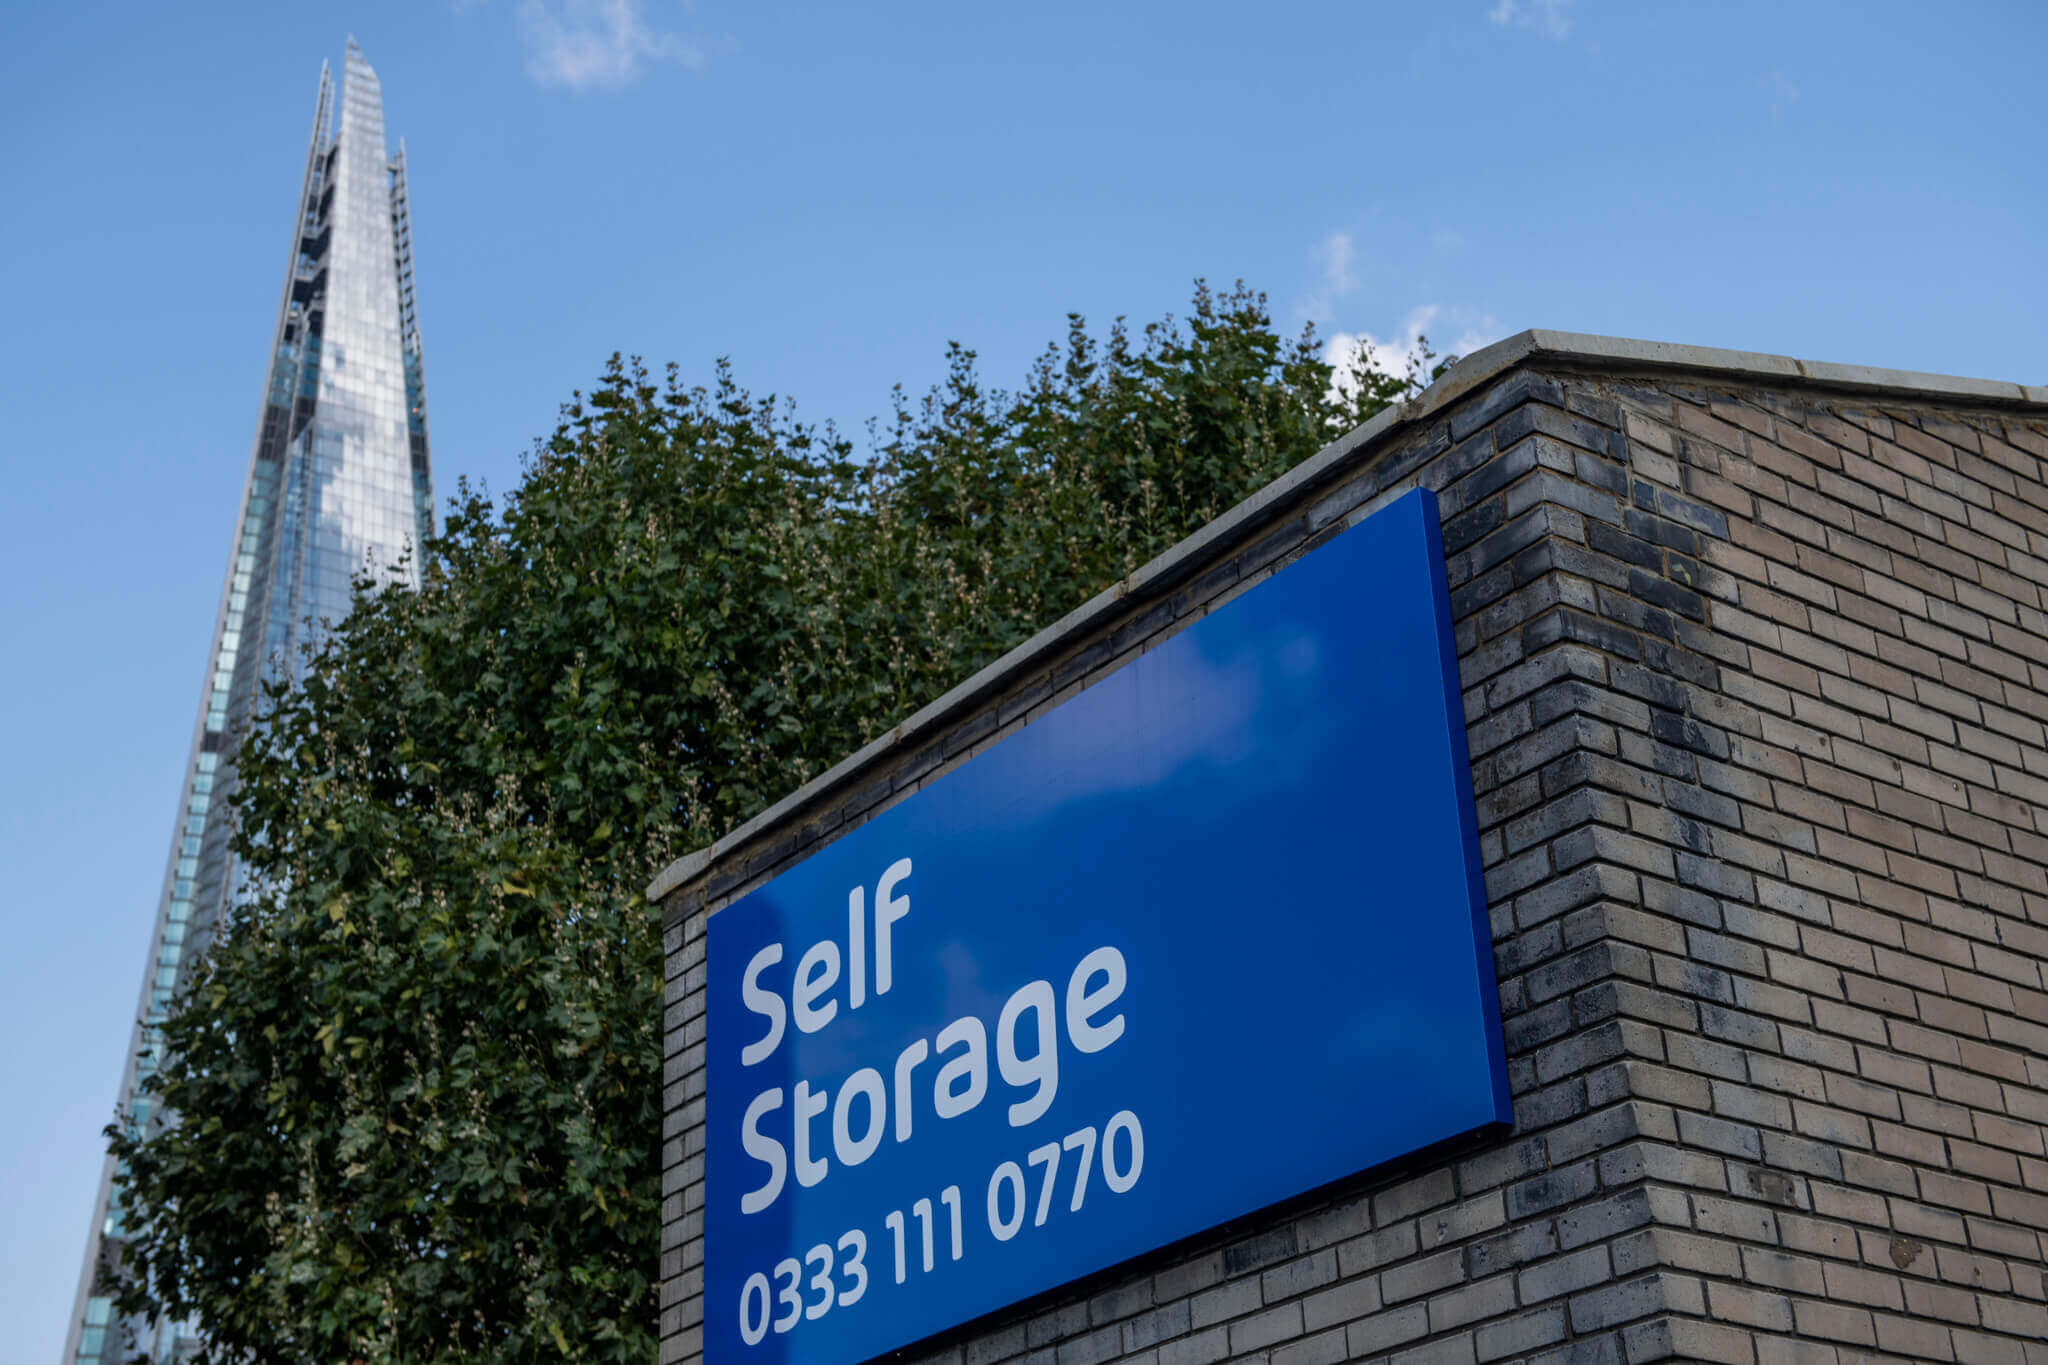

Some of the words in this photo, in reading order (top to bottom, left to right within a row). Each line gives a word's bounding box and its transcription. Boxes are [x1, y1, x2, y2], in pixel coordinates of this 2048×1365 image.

[742, 857, 912, 1066] Self
[741, 946, 1127, 1215] Storage
[739, 1229, 868, 1346] 0333
[886, 1185, 963, 1285] 111
[987, 1110, 1144, 1241] 0770
